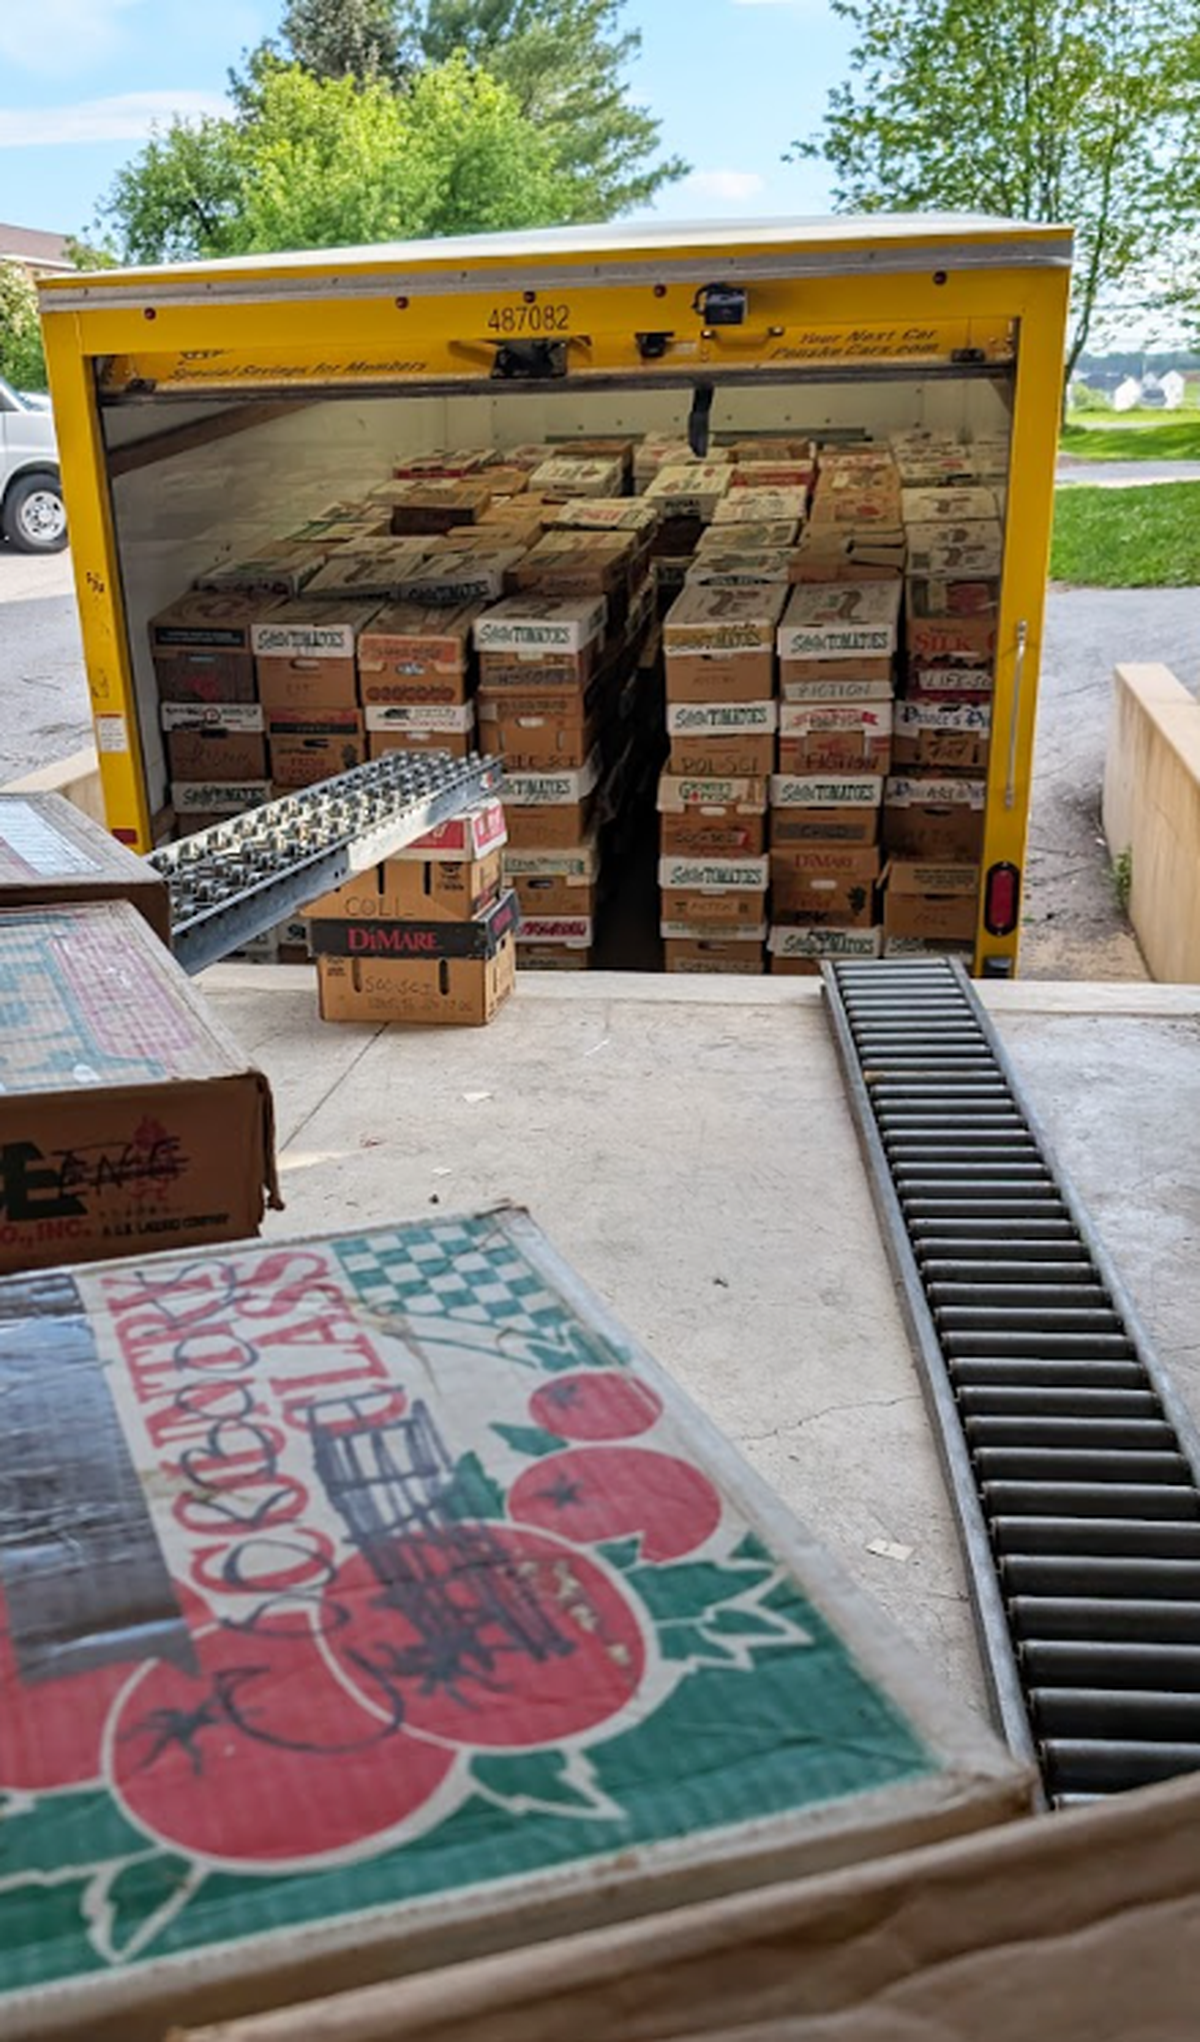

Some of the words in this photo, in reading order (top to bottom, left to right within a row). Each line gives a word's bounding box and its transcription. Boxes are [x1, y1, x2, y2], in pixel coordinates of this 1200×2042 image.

[487, 304, 570, 332] 487082
[801, 332, 843, 345] Your
[847, 330, 896, 343] Next
[902, 328, 938, 341] Car
[168, 365, 239, 382] Special
[238, 363, 307, 377] Savings
[313, 361, 341, 375] for
[344, 360, 427, 373] Members
[36, 1218, 92, 1242] INC.
[232, 1250, 409, 1434] CLASS
[101, 1268, 336, 1597] COUNTRY
